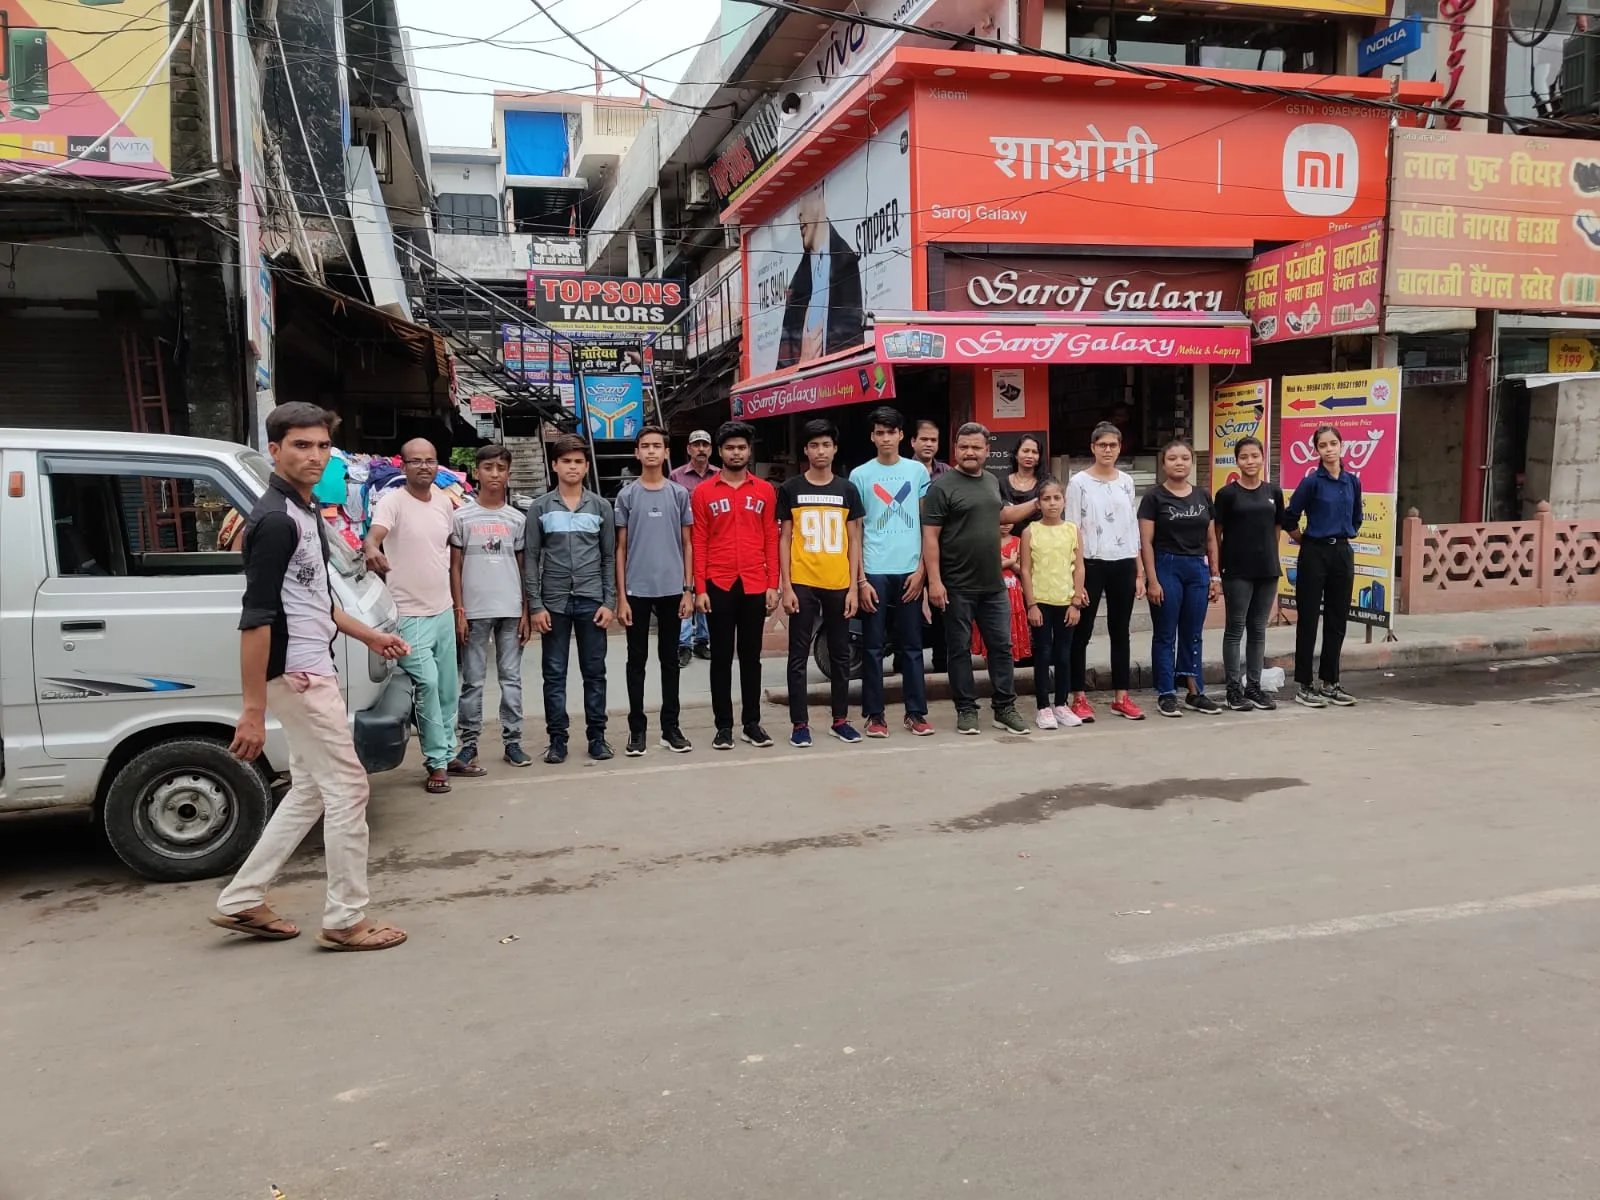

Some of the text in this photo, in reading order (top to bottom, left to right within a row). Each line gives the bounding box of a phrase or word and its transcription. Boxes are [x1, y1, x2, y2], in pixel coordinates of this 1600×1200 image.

[1366, 28, 1407, 54] NOKIA
[929, 88, 968, 101] Xiaomi
[1286, 104, 1314, 115] GSTN
[113, 142, 149, 151] AVITA
[989, 124, 1158, 183] शाओमी
[1403, 152, 1458, 181] लाल
[1465, 155, 1503, 191] फुट
[854, 198, 900, 260] STOPPER
[931, 204, 1027, 224] Saroj Galaxy
[1400, 203, 1457, 239] पंजाबी
[1285, 245, 1327, 282] पंजाबी
[1333, 229, 1381, 271] बालाजी
[540, 279, 681, 306] TOPSONS
[967, 270, 1223, 312] Saroj Galaxy
[1245, 264, 1280, 293] लाल
[1397, 263, 1464, 297] बालाजी
[758, 278, 770, 311] THE
[559, 305, 665, 322] TAILORS
[955, 331, 1241, 360] Saroj Galaxy Mobile & Laptop
[747, 391, 778, 414] Saroj
[778, 386, 817, 411] Galaxy
[800, 509, 843, 554] 90
